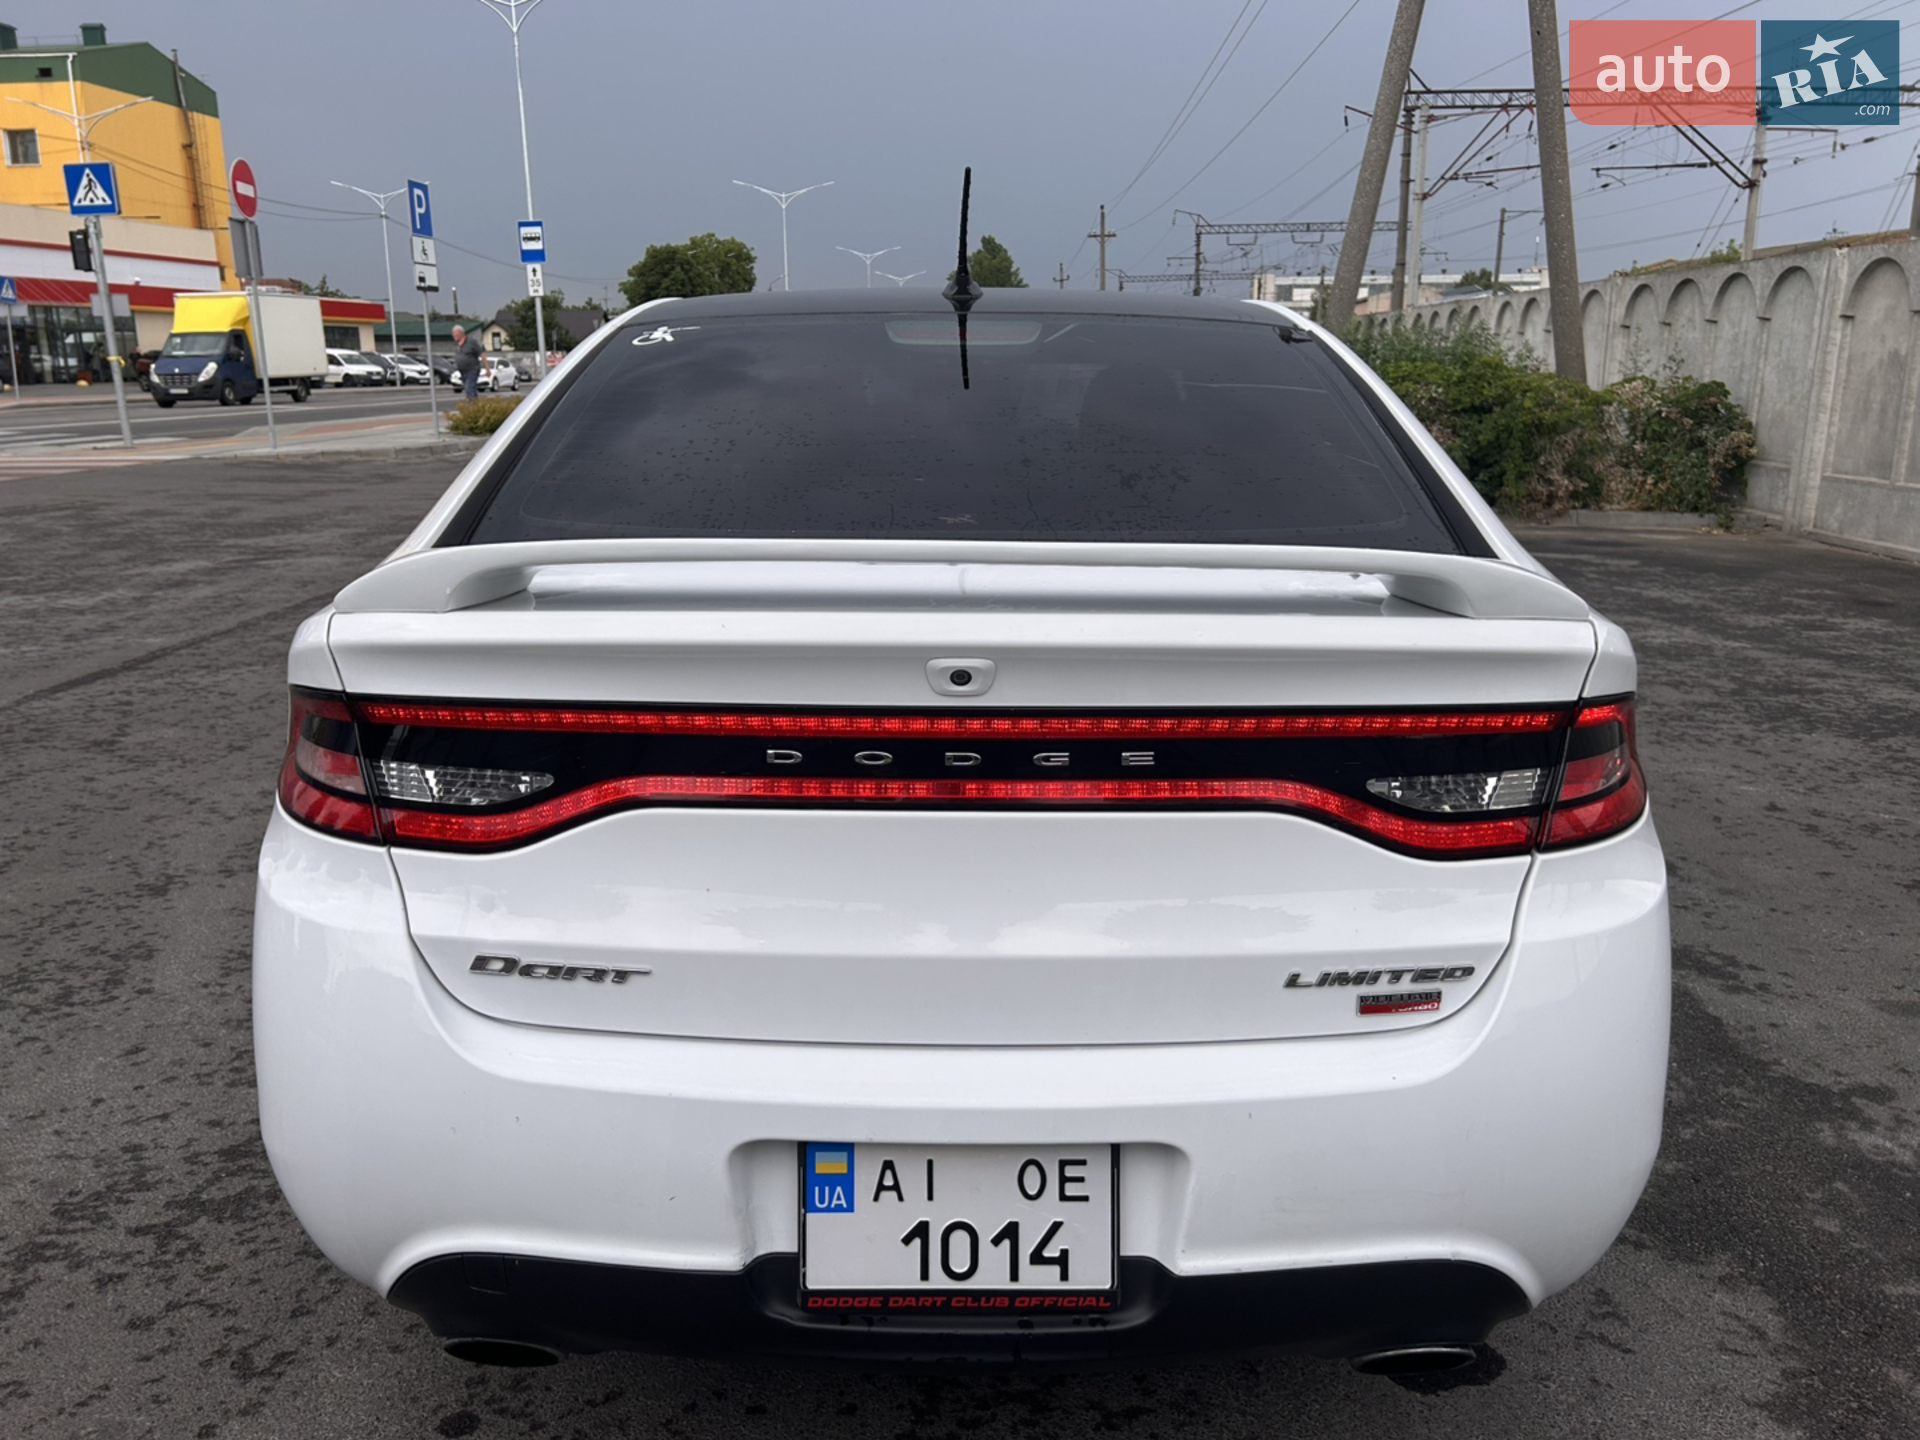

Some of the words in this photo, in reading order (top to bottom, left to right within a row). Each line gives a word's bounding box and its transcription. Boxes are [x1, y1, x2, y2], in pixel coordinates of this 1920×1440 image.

[413, 187, 426, 229] P
[530, 278, 542, 288] 35
[766, 748, 1156, 767] DODGE
[1283, 963, 1476, 989] LIMITED
[872, 1158, 934, 1203] AI
[1017, 1158, 1090, 1203] OE
[814, 1185, 848, 1209] UA
[900, 1218, 1070, 1283] 1014
[806, 1296, 882, 1309] DODGE
[888, 1296, 947, 1308] DART
[950, 1296, 1009, 1308] CLUB
[1014, 1296, 1112, 1308] OFFICIAL
